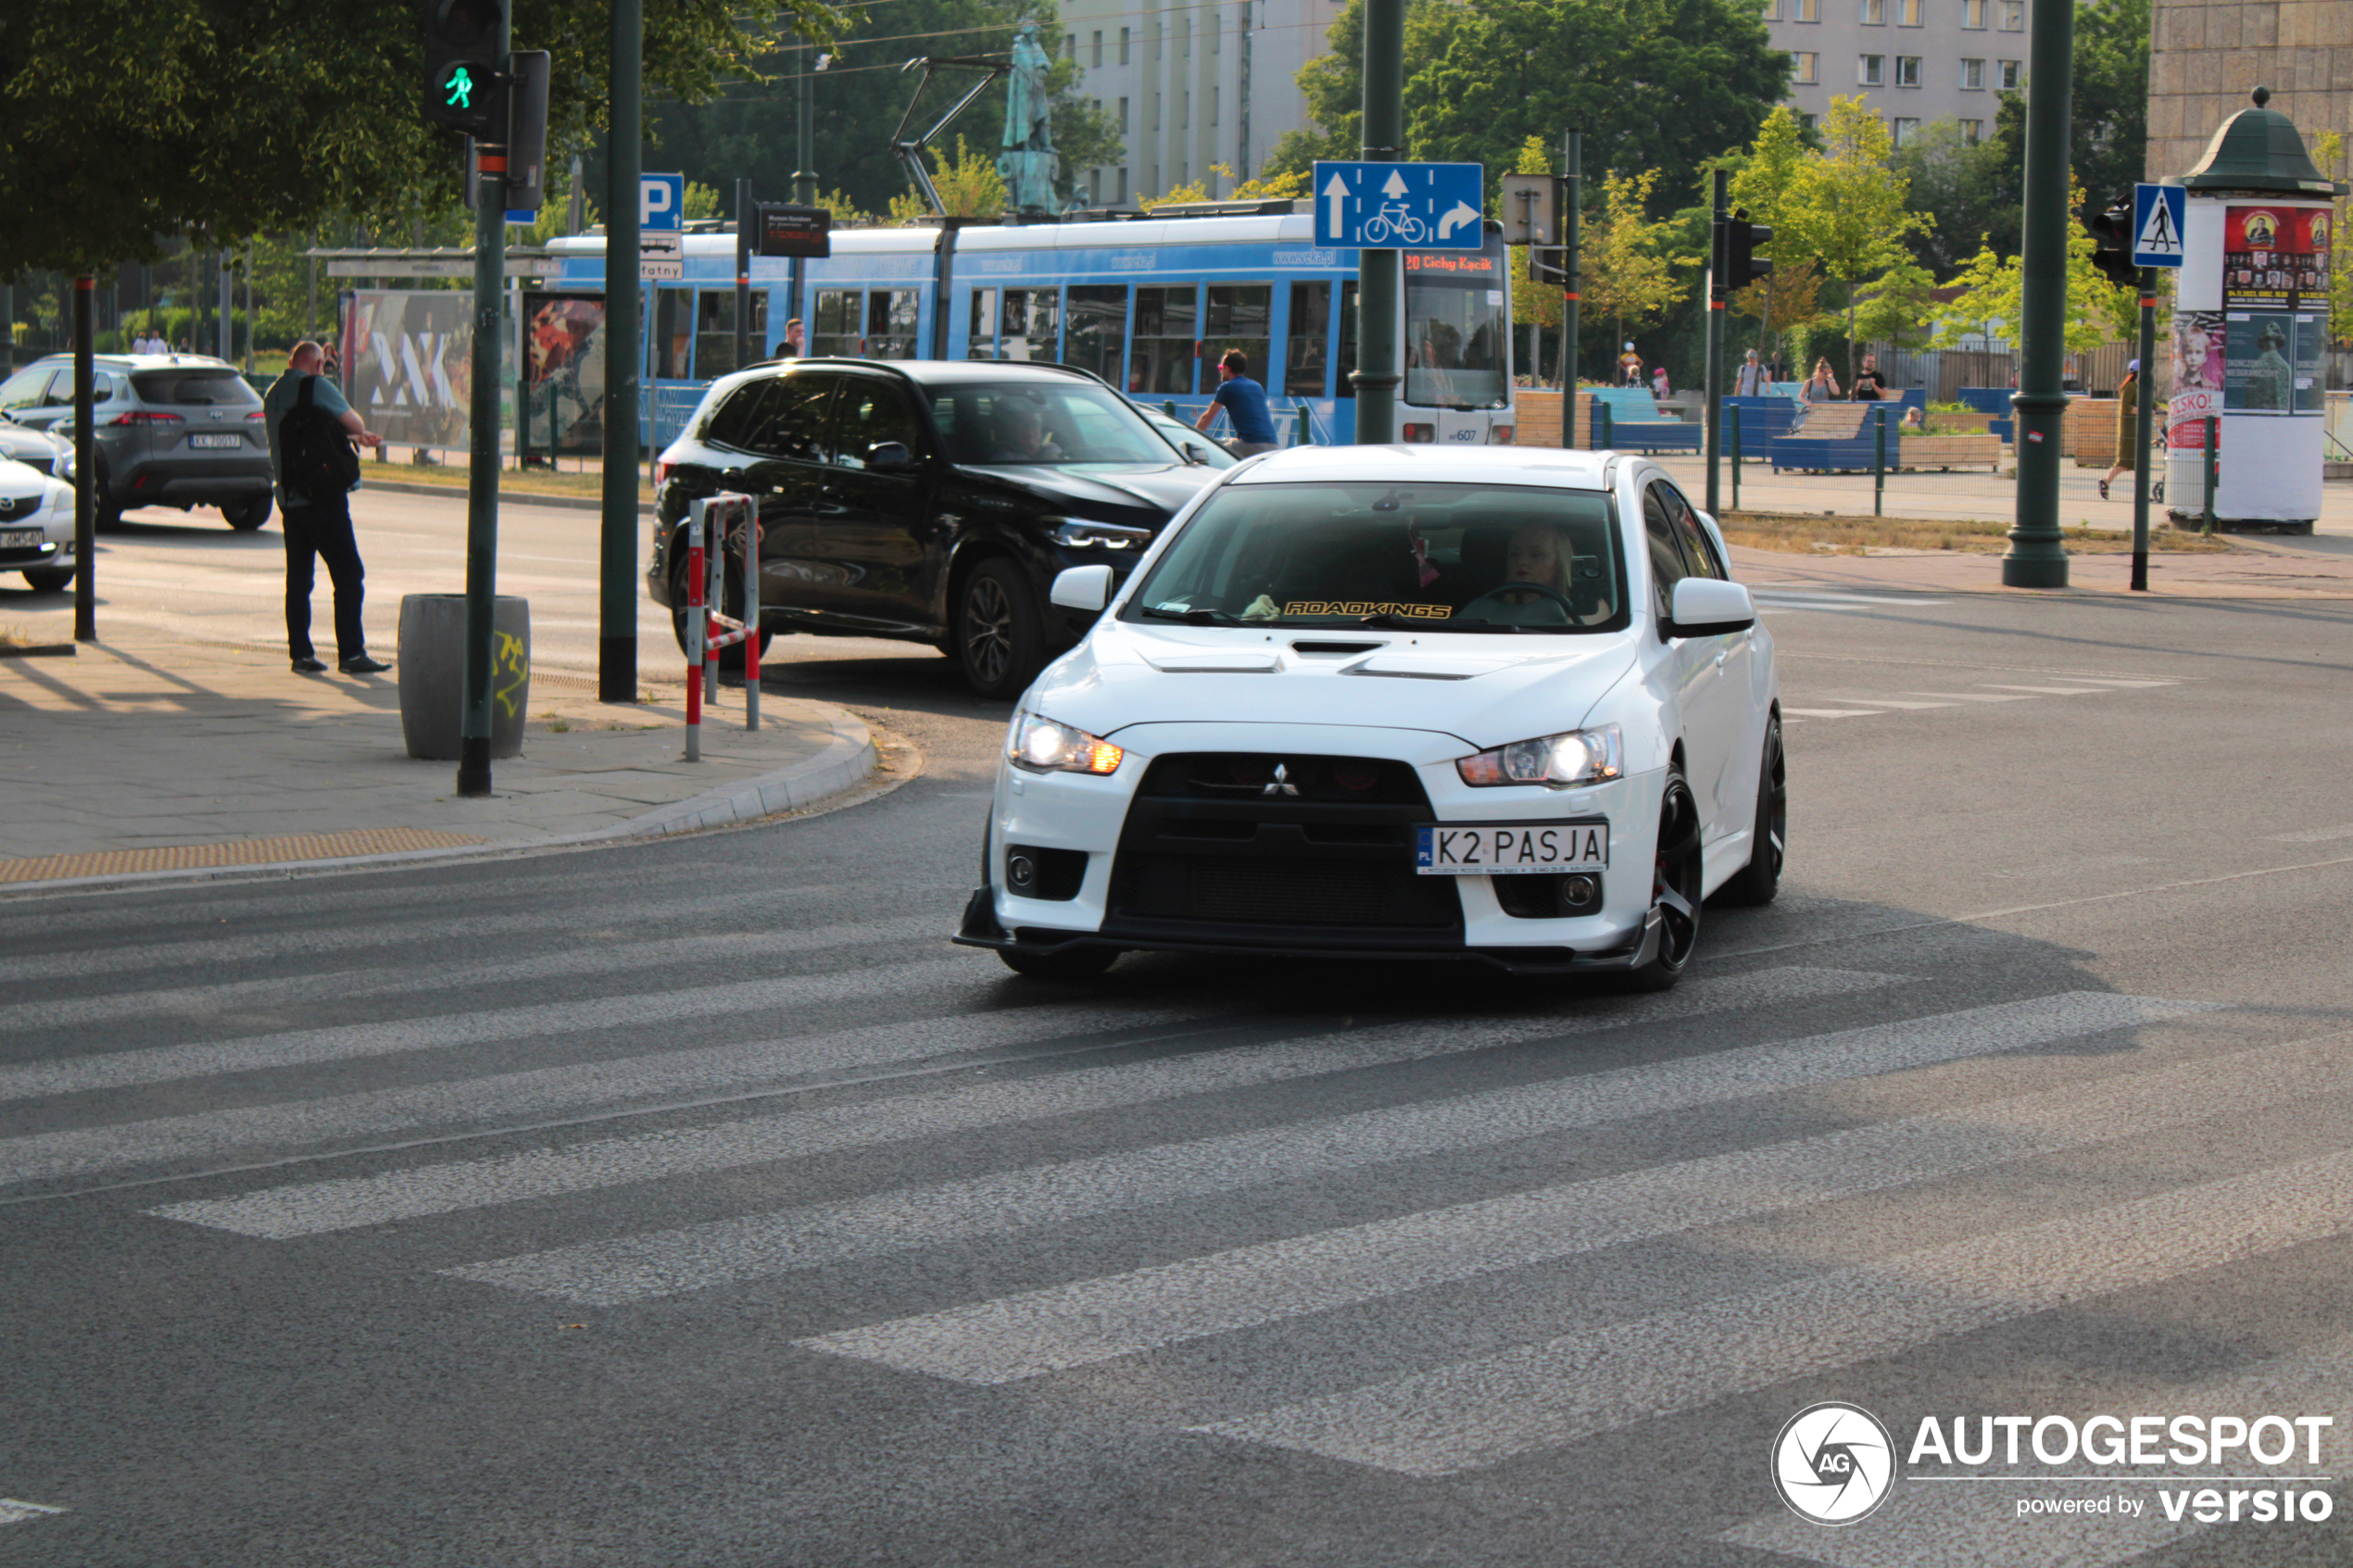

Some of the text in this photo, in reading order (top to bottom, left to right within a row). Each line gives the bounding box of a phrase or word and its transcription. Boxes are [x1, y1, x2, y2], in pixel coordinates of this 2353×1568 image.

[641, 181, 672, 224] P
[1273, 248, 1336, 267] www.veka.pl
[1406, 255, 1492, 272] 20 Cichy Kącik
[641, 265, 679, 279] łatny
[2169, 394, 2211, 417] OLSKO!
[195, 435, 208, 446] KK
[1284, 602, 1453, 619] ROADKINGS
[1440, 829, 1601, 863] K2 PASJA
[1418, 852, 1431, 860] PL
